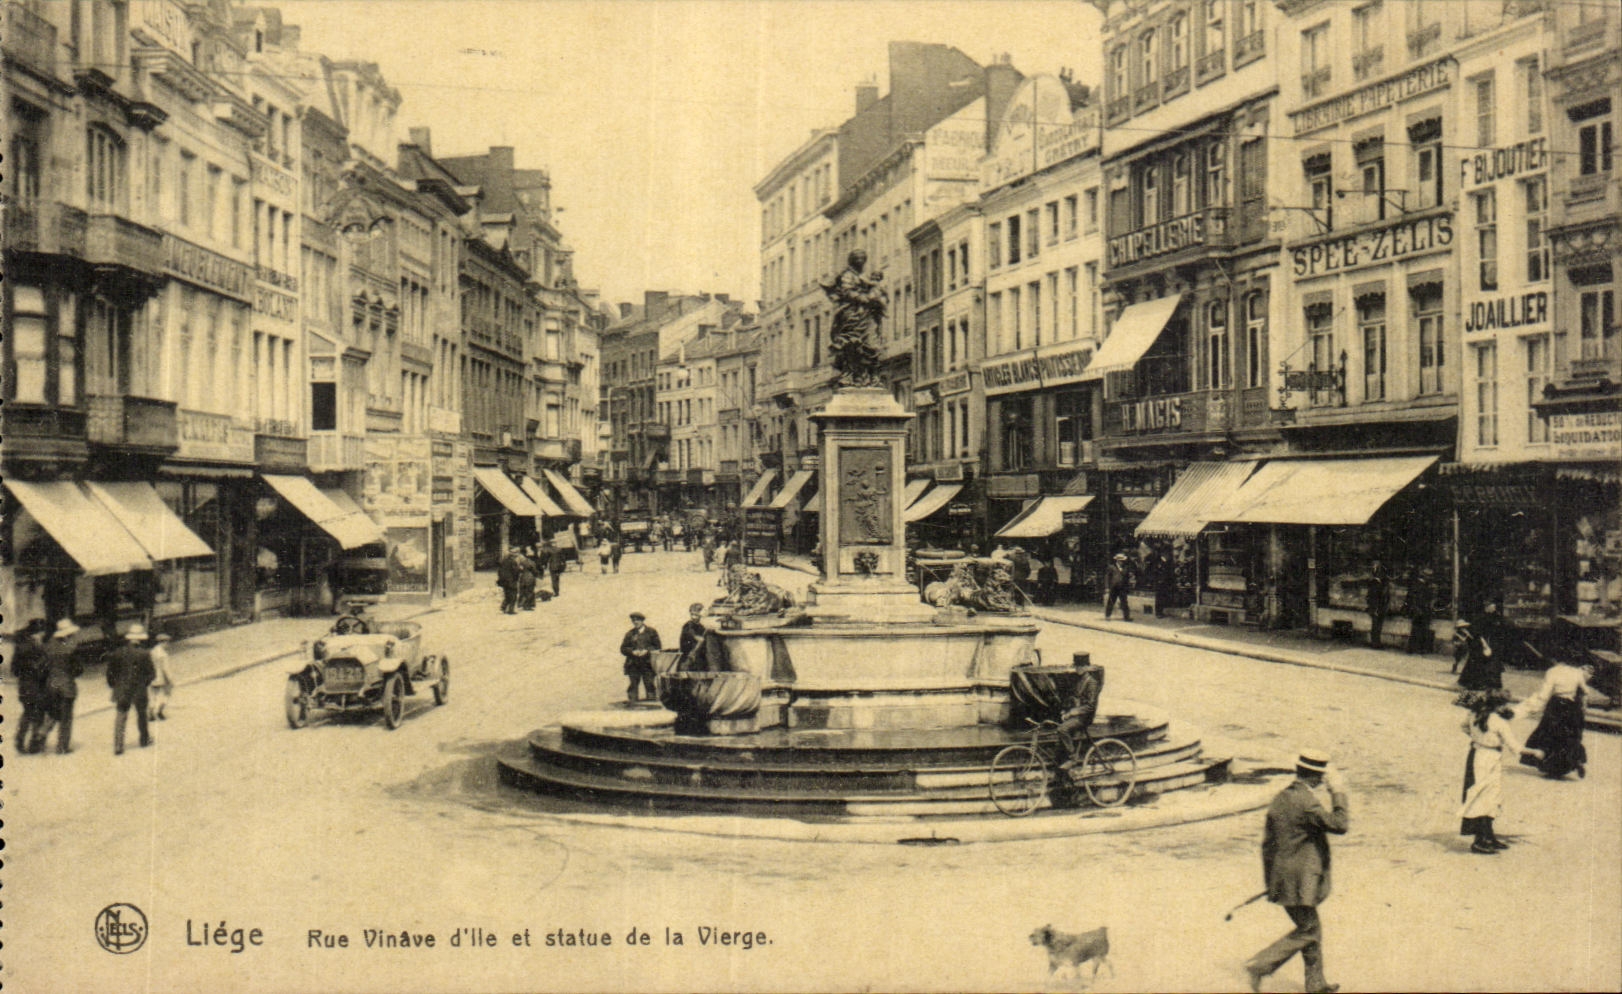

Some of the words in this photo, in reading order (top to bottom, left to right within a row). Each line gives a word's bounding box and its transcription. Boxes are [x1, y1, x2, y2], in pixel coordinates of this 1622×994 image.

[1361, 60, 1449, 111] PAPETERIE
[1474, 137, 1547, 185] BIJOUTIER
[1110, 212, 1203, 266] CHAPELLERIE
[1293, 217, 1454, 276] SPEE-ZELIS
[1465, 291, 1548, 333] JOAILLIER
[1135, 397, 1181, 430] MAGIS
